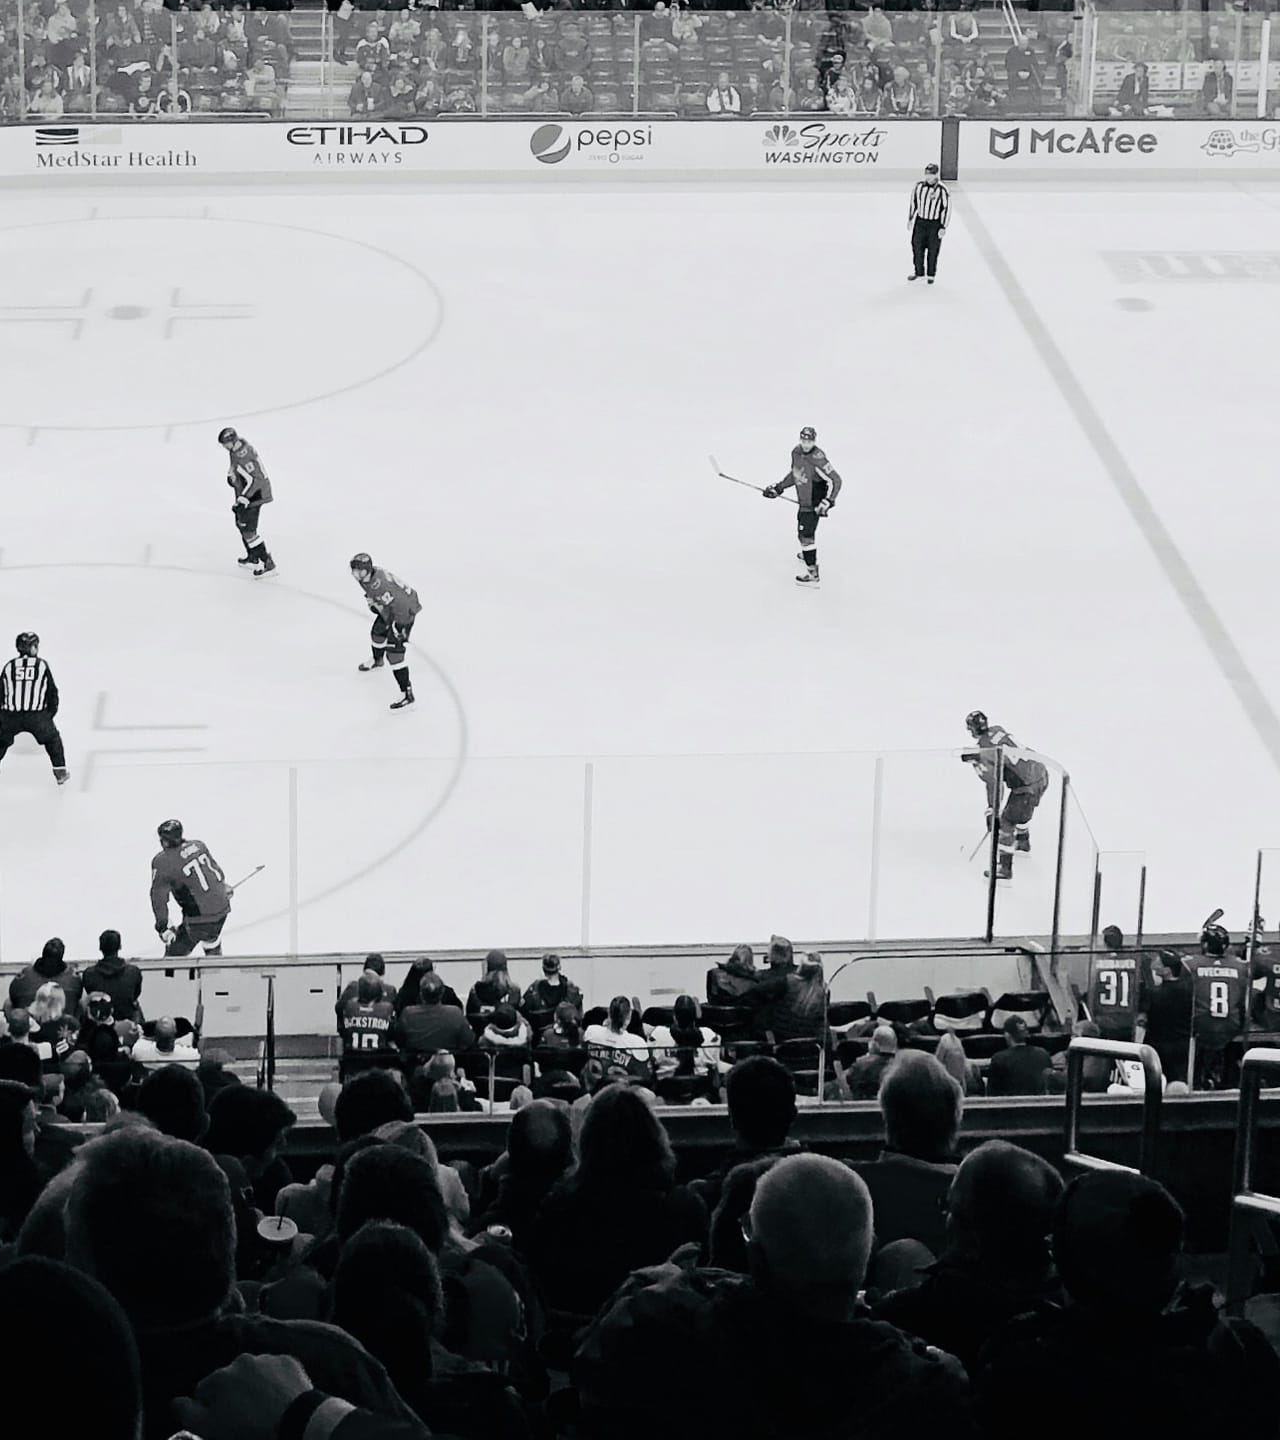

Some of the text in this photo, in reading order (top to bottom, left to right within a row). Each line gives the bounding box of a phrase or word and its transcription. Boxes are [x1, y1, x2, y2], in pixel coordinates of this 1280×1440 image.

[285, 126, 430, 147] ETIHAD
[576, 124, 654, 152] pepsi
[798, 122, 889, 152] Sports
[1029, 126, 1159, 155] McAfee
[1239, 129, 1260, 144] the
[35, 149, 198, 169] MedStar Health
[311, 150, 403, 166] AIRWAYS
[763, 151, 880, 165] WASHINGTON
[182, 853, 224, 893] 77
[1099, 970, 1130, 1007] 31
[1209, 981, 1229, 1018] 8
